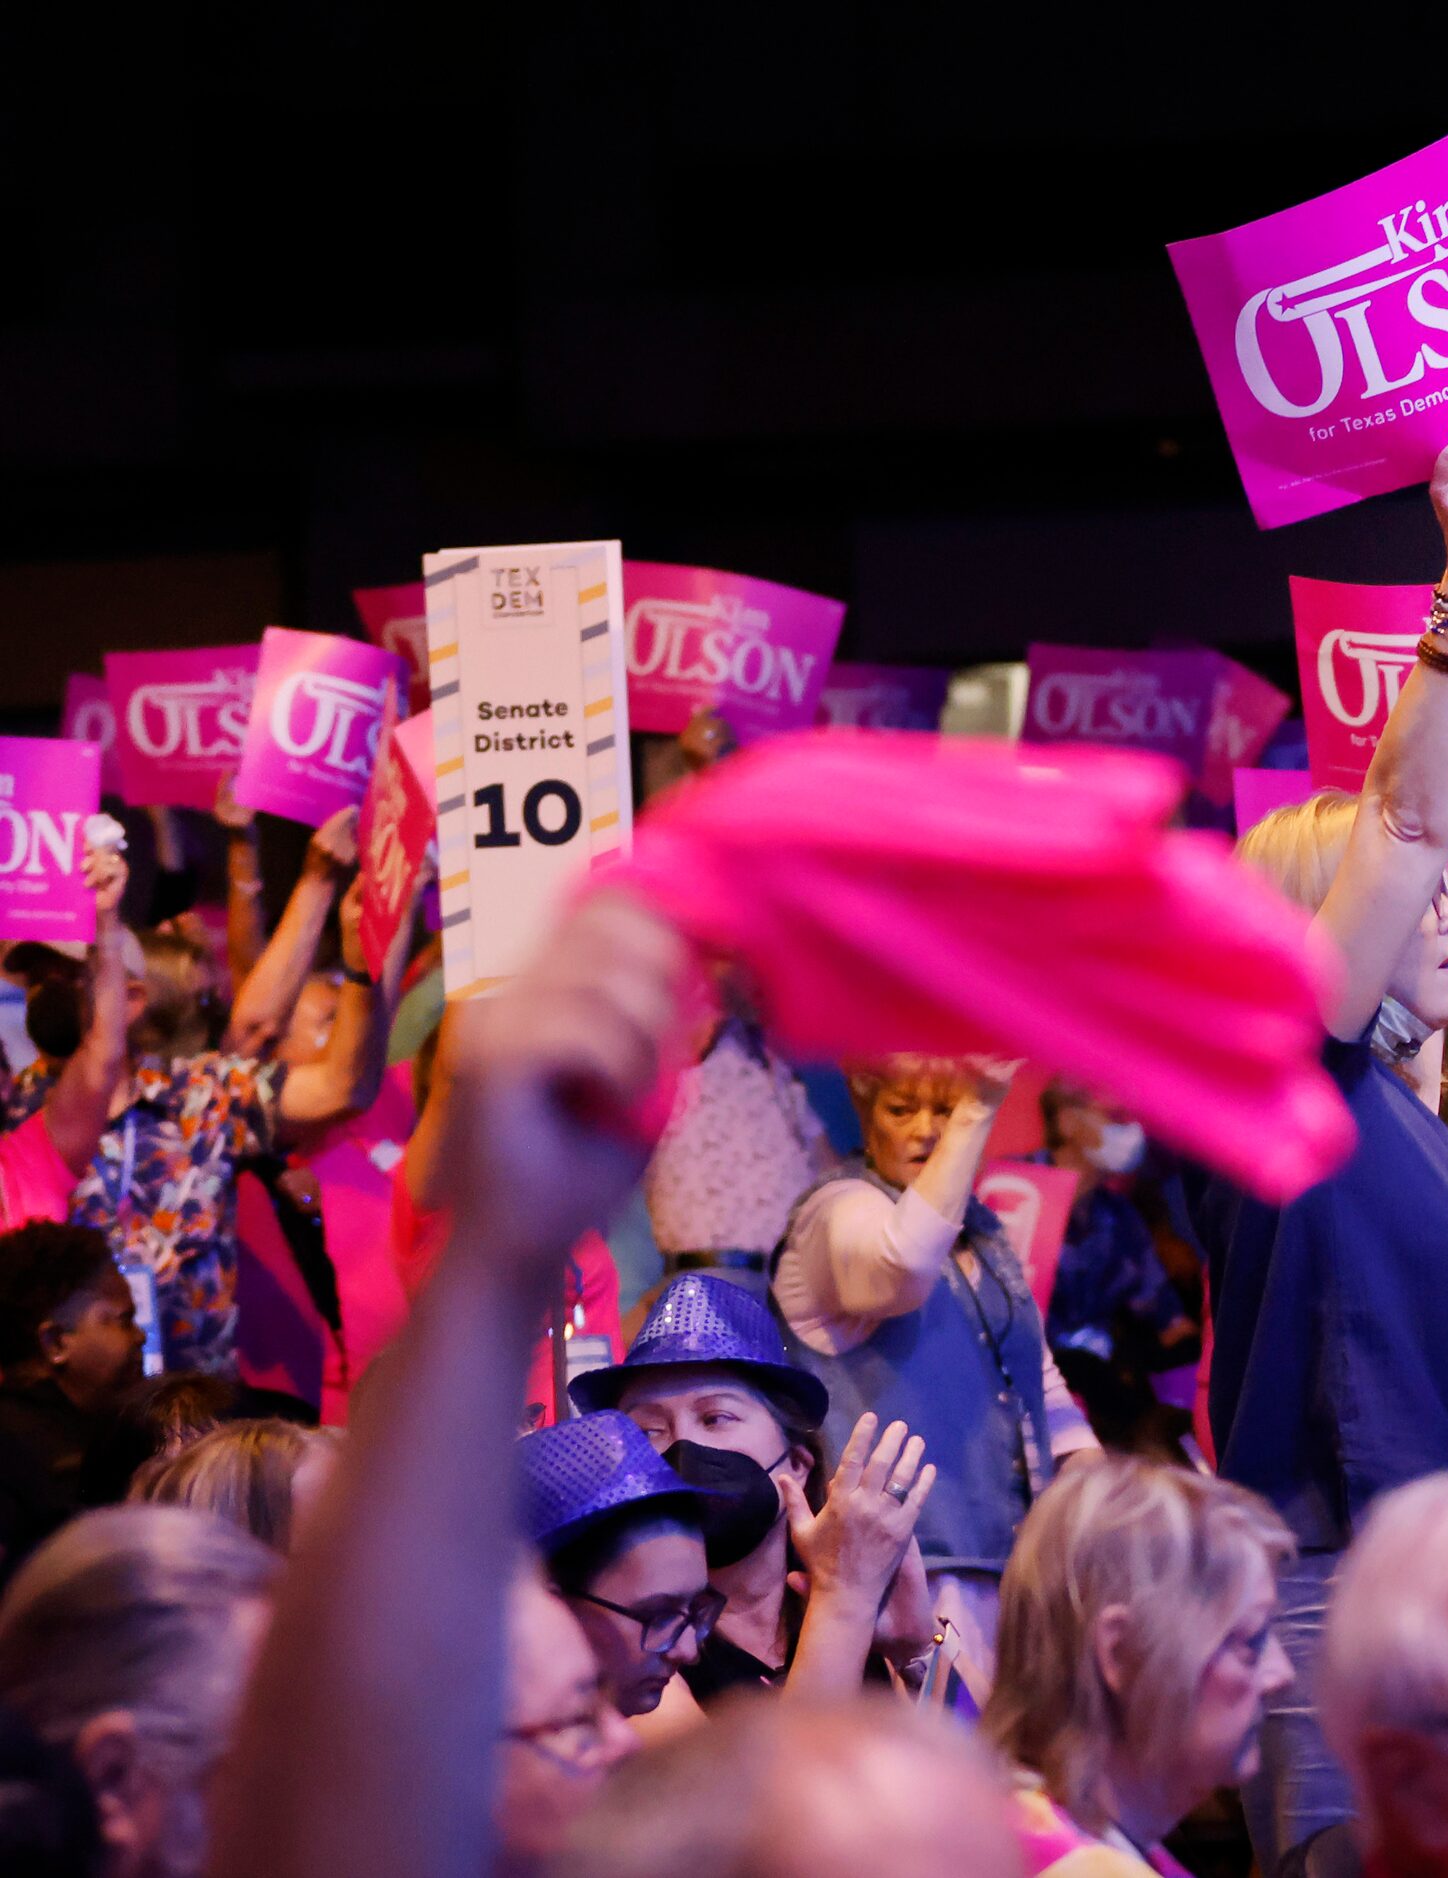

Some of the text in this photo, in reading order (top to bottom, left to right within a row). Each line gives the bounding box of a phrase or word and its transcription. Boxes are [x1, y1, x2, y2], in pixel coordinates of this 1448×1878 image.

[1308, 425, 1336, 442] for
[1340, 406, 1397, 433] Texas
[490, 566, 542, 588] TEX
[490, 590, 545, 610] DEM
[625, 596, 817, 706] OLSON
[126, 680, 251, 758] OLS
[476, 699, 569, 721] Senate
[474, 730, 576, 753] District
[472, 778, 583, 849] 10
